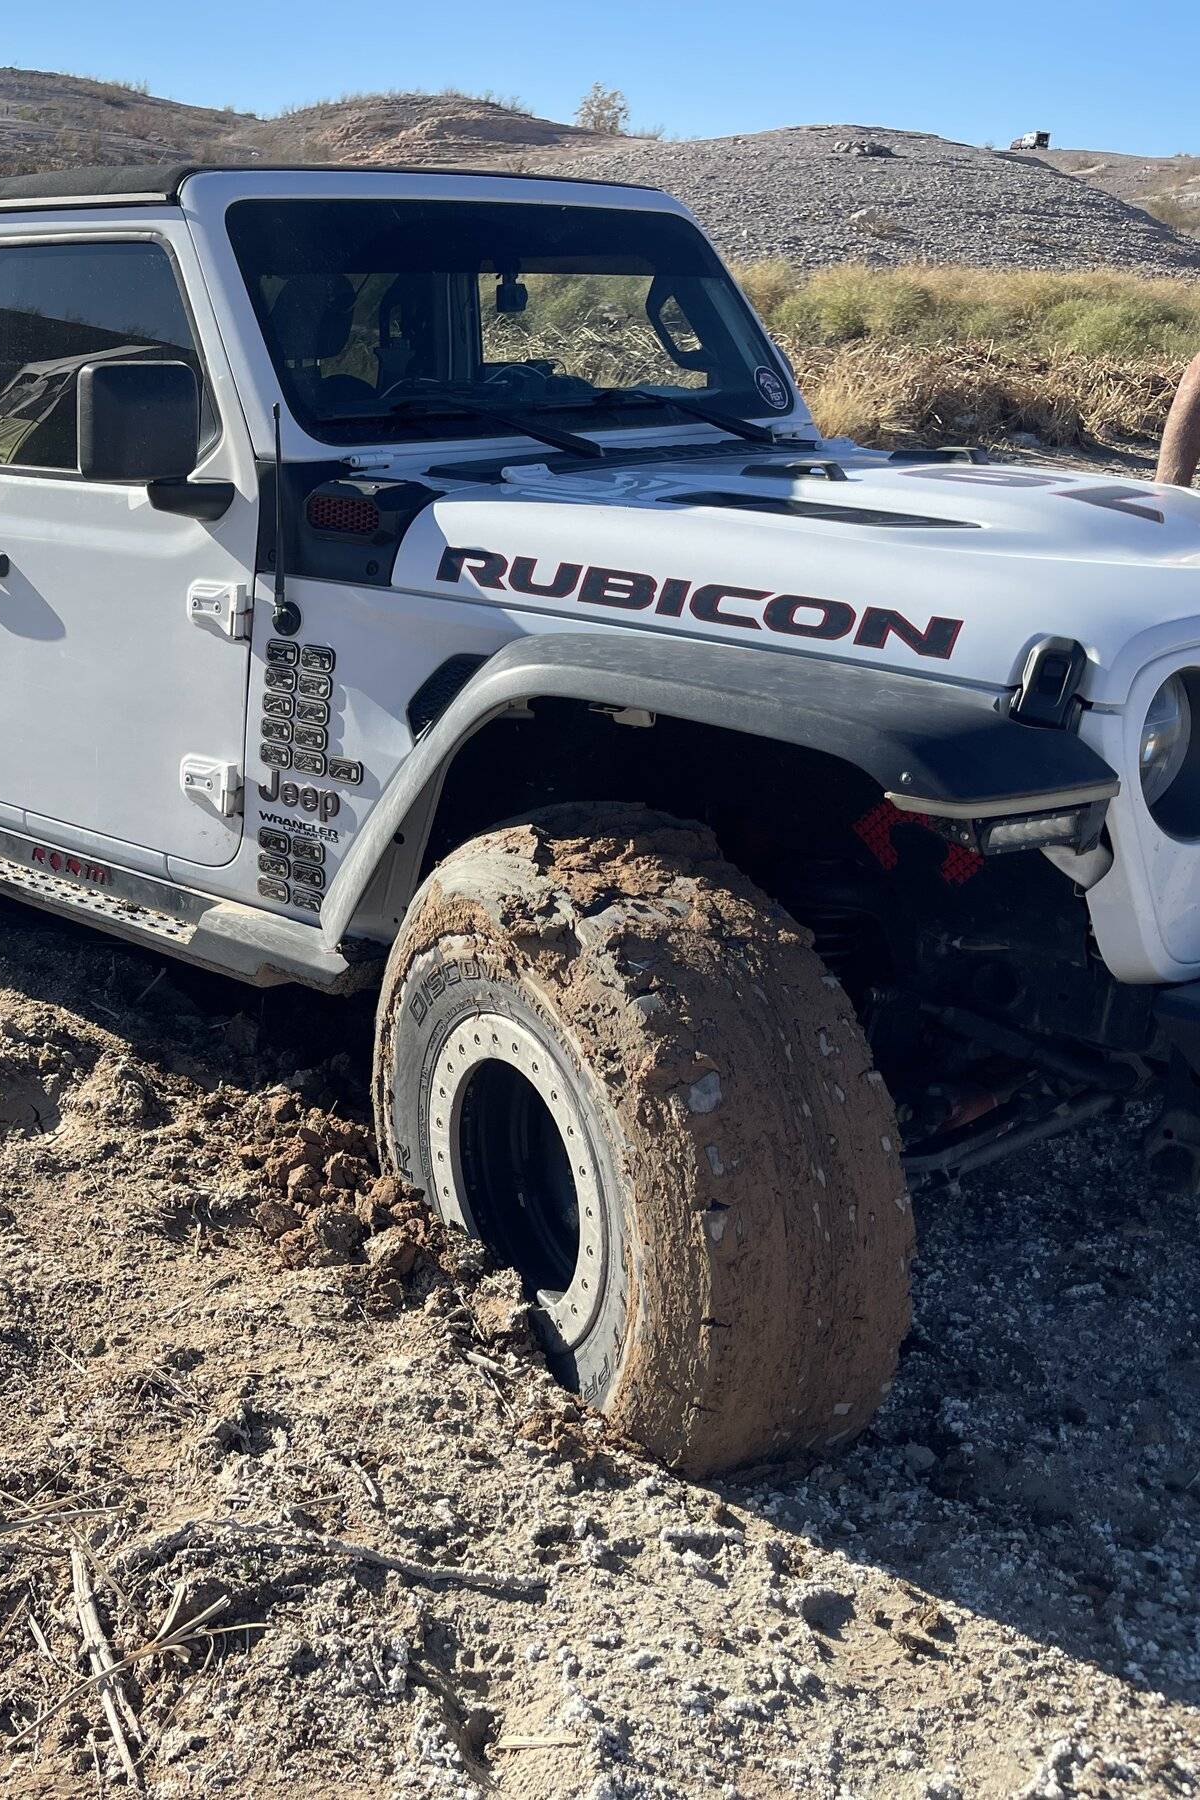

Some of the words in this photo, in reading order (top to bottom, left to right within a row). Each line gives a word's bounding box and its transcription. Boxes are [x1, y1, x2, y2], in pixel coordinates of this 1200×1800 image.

[435, 545, 965, 661] RUBICON
[258, 768, 341, 823] Jeep
[258, 809, 339, 839] WRANGLER
[282, 825, 339, 844] UNLIMITED
